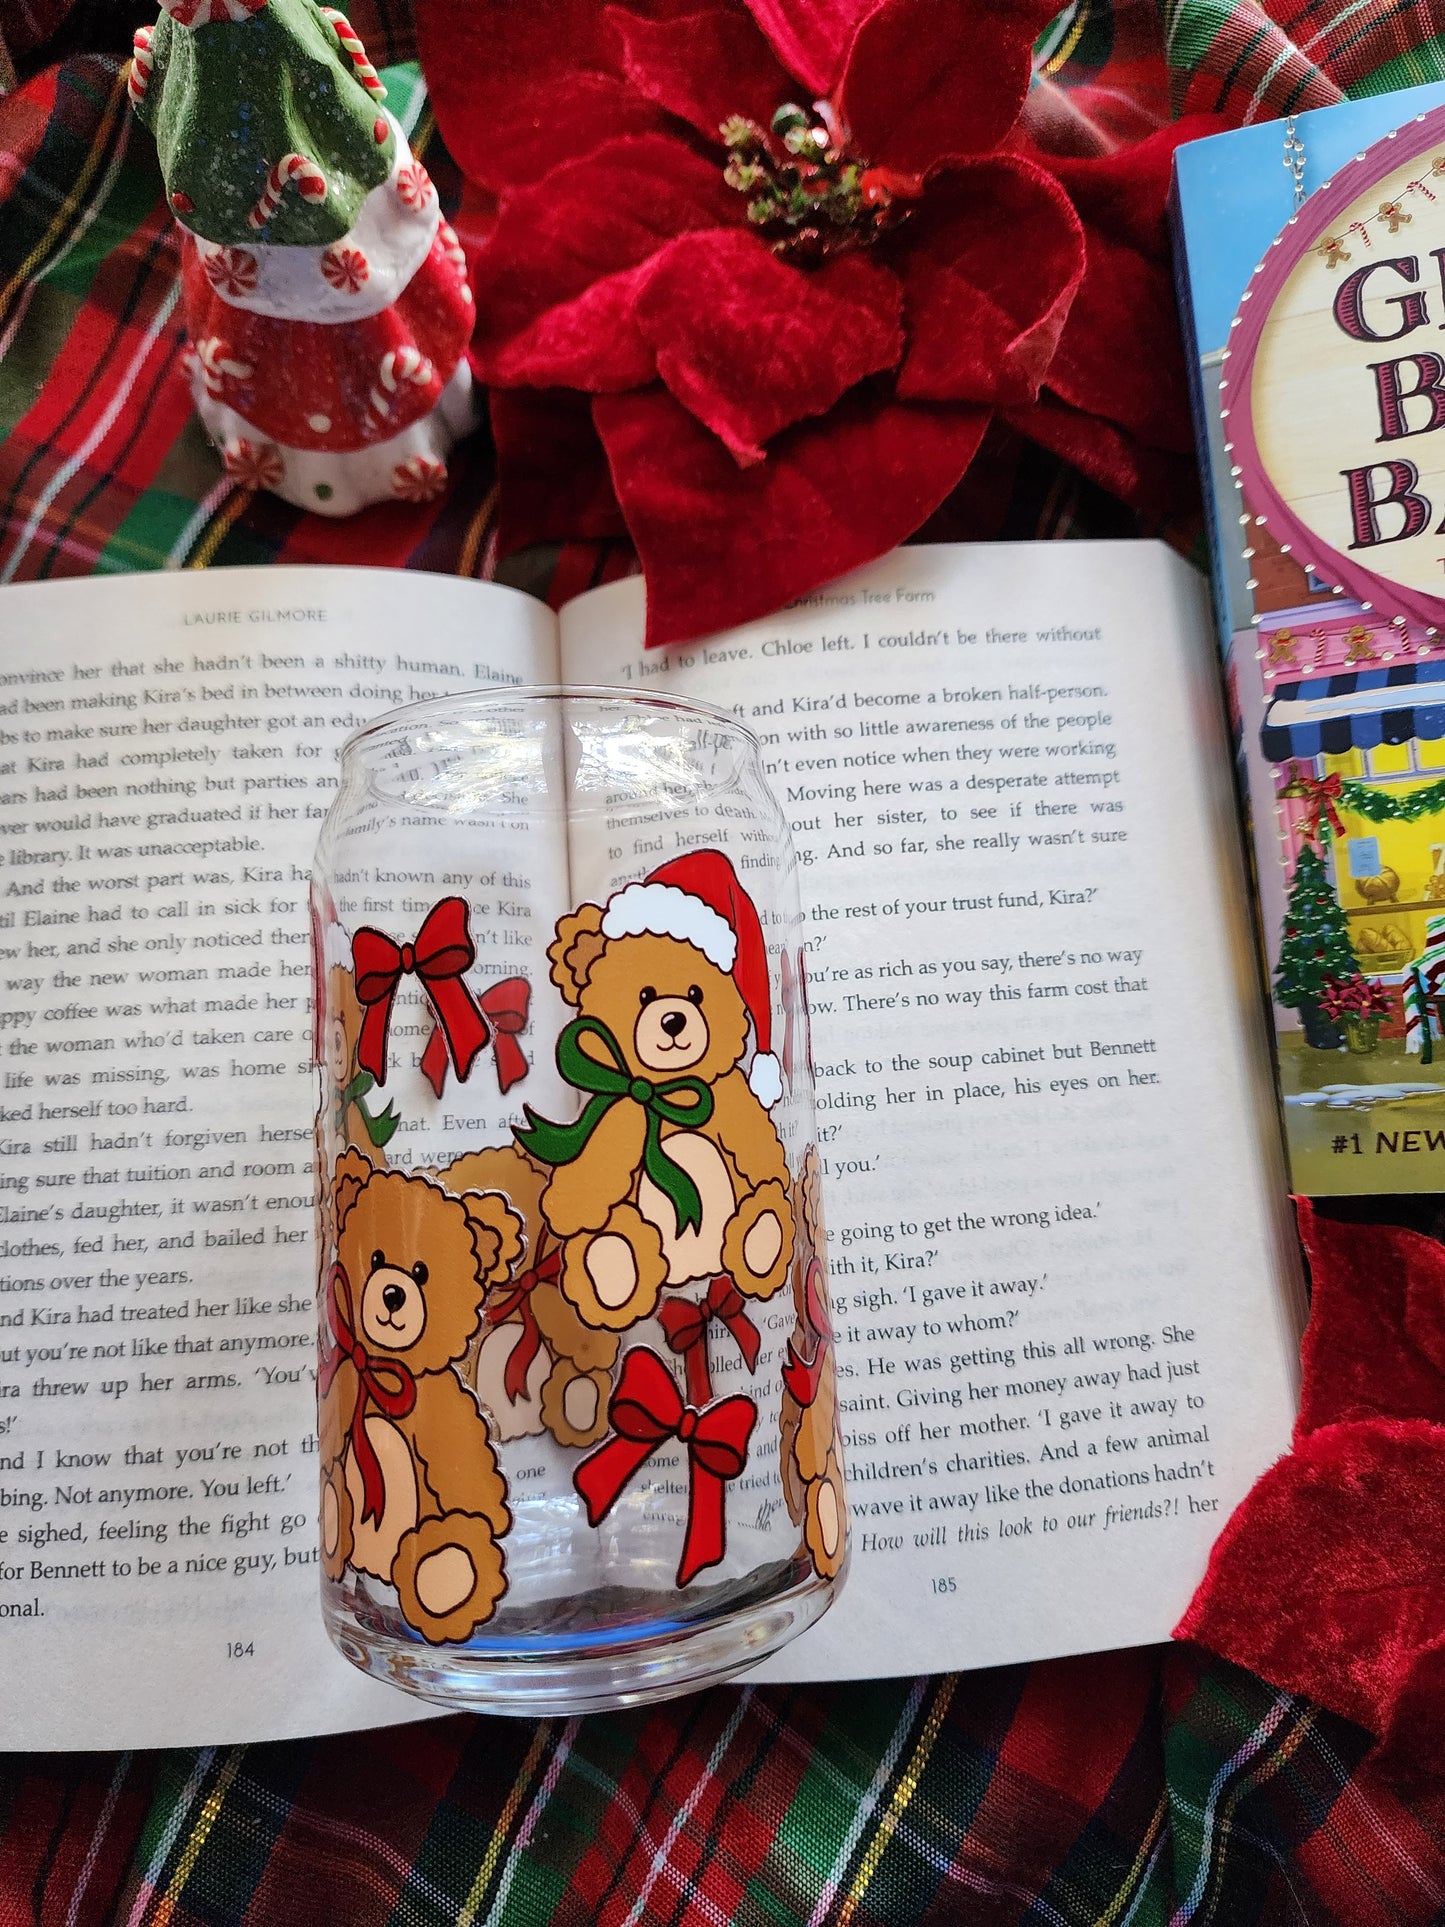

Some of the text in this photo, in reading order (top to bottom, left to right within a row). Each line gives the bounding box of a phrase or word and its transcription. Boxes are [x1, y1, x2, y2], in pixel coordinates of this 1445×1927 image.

[1339, 458, 1445, 550] B
[184, 608, 328, 626] LAURIE GILMORE
[73, 652, 524, 686] her that she hadn't been a shitty human. Elaine
[622, 625, 1101, 681] 'I had to leave. Chloe left. I couldn't be there without
[23, 683, 404, 714] been making Kira's bed in between doing
[751, 684, 1108, 717] and Kira'd become a broken half-person.
[26, 742, 323, 774] Kira had completely taken for
[34, 773, 308, 803] had been nothing but parties
[785, 770, 1121, 803] Moving here was a desperate attempt
[826, 828, 1128, 860] And so far, she really wasn't sure
[5, 866, 284, 898] And the worst part was, Kira
[864, 1059, 883, 1074] to
[888, 1053, 922, 1072] the
[928, 1054, 973, 1073] soup
[981, 1046, 1046, 1065] cabinet
[1051, 1043, 1084, 1060] but
[1088, 1038, 1158, 1057] Bennett
[42, 1128, 249, 1154] still hadn't forgiven
[69, 1193, 260, 1224] daughter, it wasn't
[72, 1224, 309, 1255] fed her, and bailed her
[852, 1272, 1048, 1313] sigh. 'I gave it away.'
[866, 1324, 1195, 1377] He was getting this all wrong. She
[31, 1371, 242, 1400] threw up her arms.
[884, 1393, 1206, 1445] off her mother. 'I gave it away to
[35, 1438, 289, 1471] I know that you're not
[16, 1510, 307, 1550] sighed, feeling the fight go
[862, 1494, 1219, 1552] How will this look to our friends?! her
[29, 1545, 319, 1581] Bennett to be a nice guy, but
[931, 1576, 957, 1595] 185
[226, 1640, 256, 1659] 184
